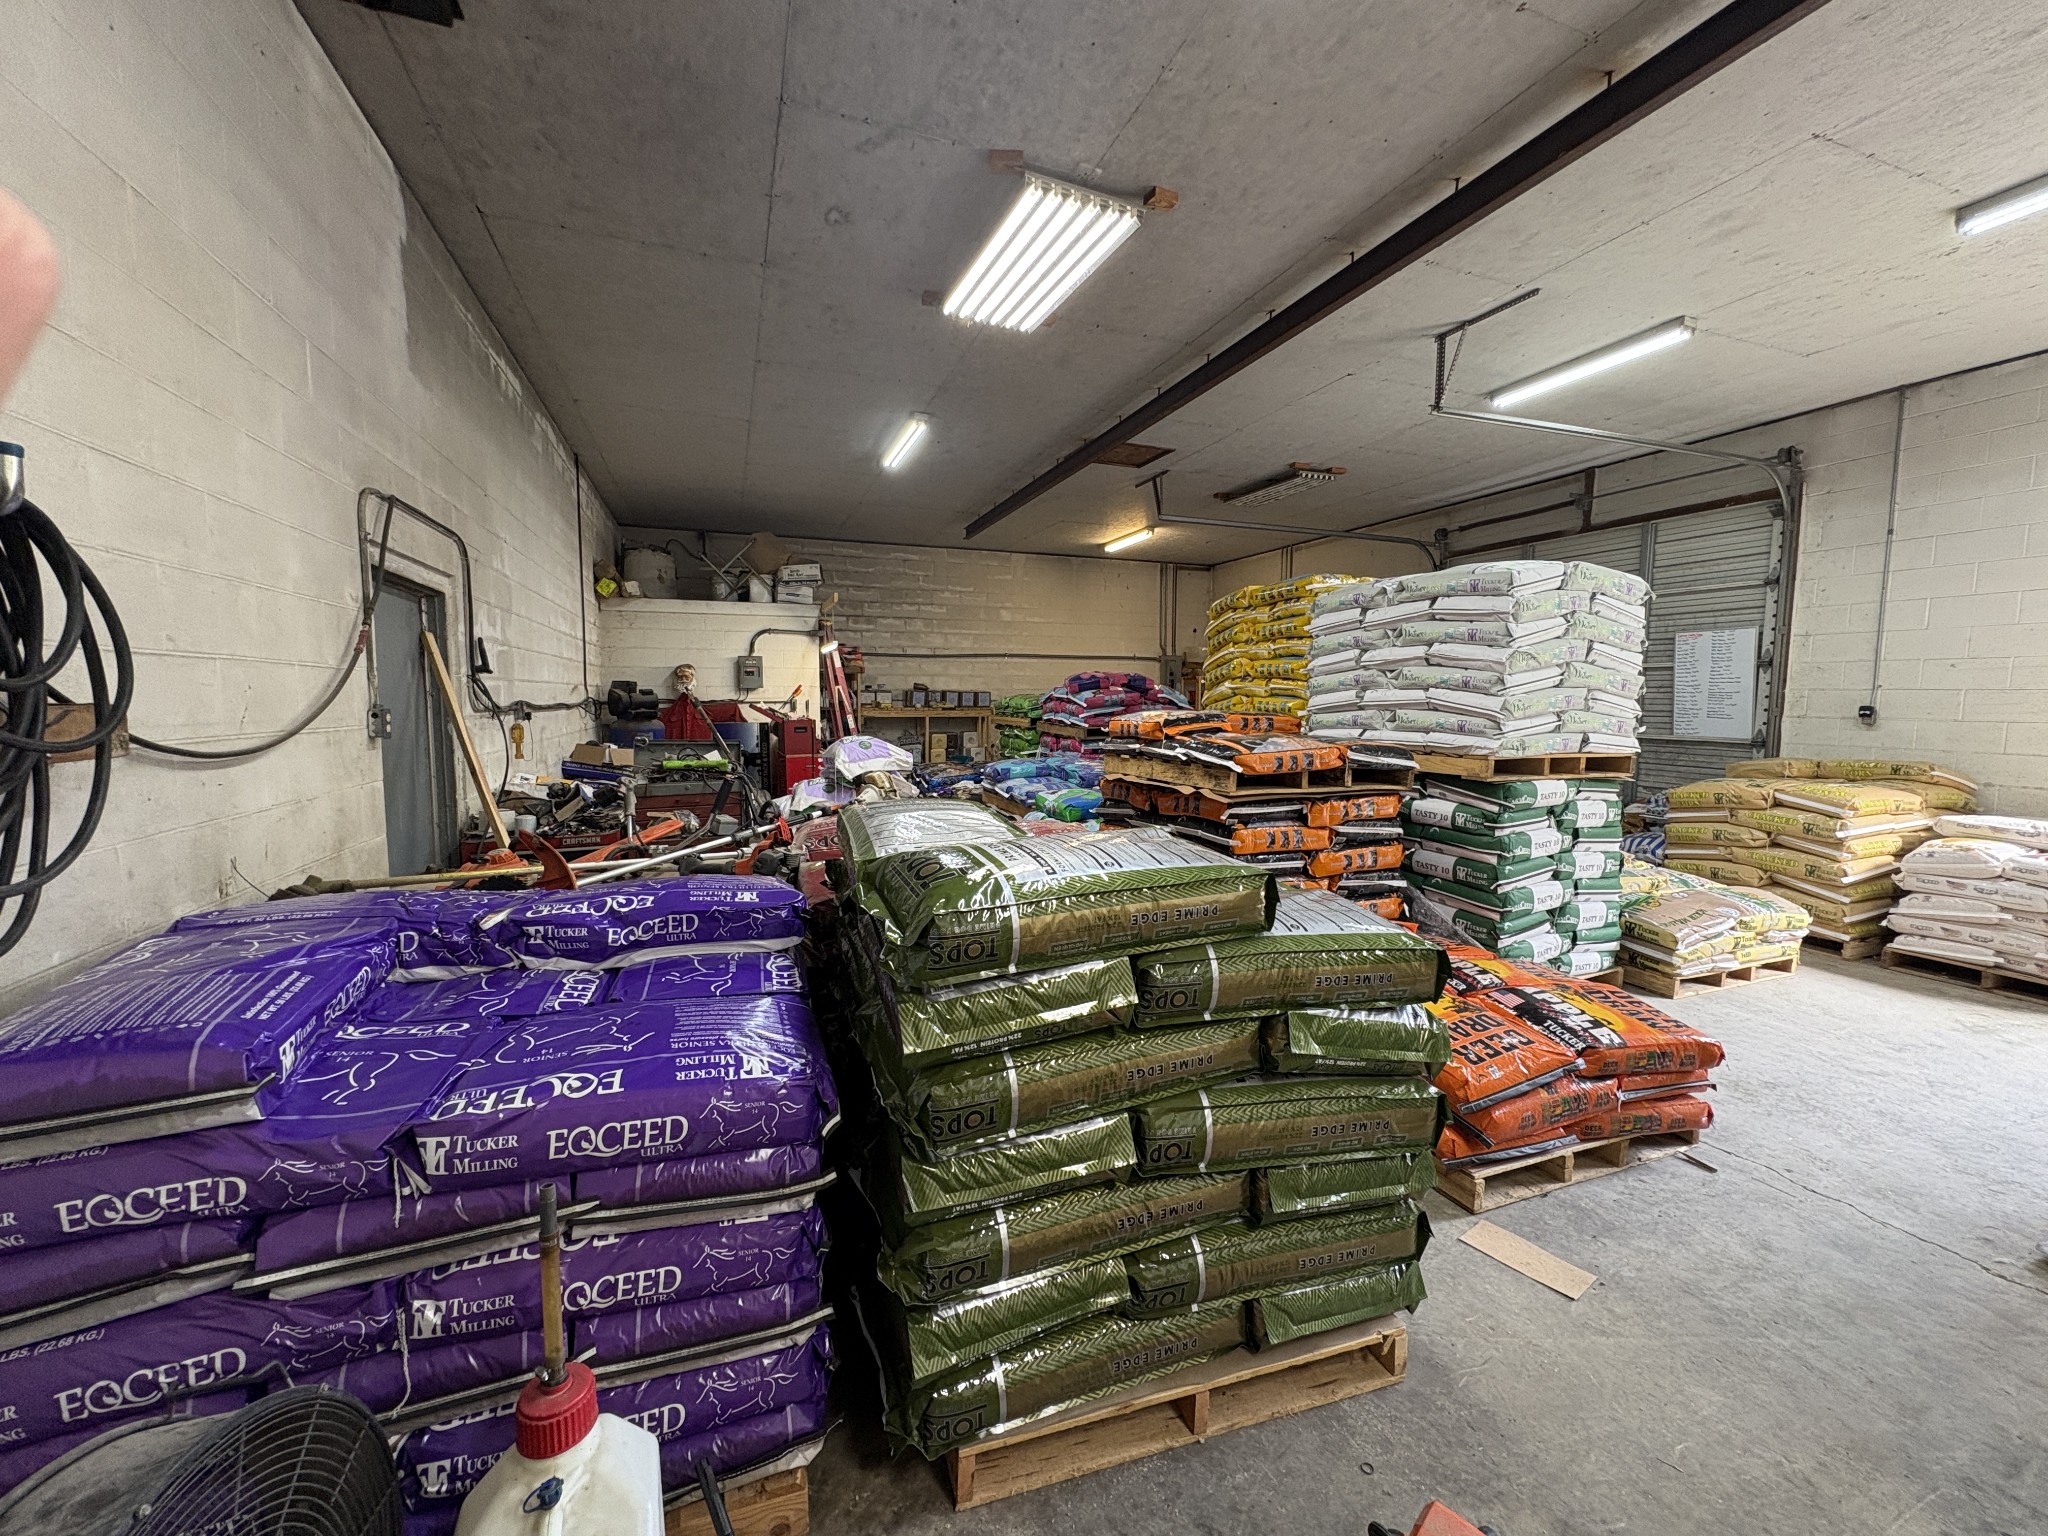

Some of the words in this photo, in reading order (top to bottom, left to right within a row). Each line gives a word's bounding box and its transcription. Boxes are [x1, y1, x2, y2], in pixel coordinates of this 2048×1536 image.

[1414, 808, 1438, 820] TASTY
[1439, 813, 1448, 821] 10
[1745, 811, 1799, 826] CRACKED
[1755, 822, 1786, 833] CORN
[562, 837, 601, 845] CRAFTSMAN
[1415, 860, 1440, 872] TASTY
[1440, 866, 1450, 875] 10
[1744, 851, 1799, 868] CRACKED
[1467, 869, 1488, 879] TUCKER
[1130, 909, 1169, 926] EDGE
[1173, 904, 1218, 921] PRIME
[545, 925, 589, 937] TUCKER
[606, 913, 699, 947] EQCEED
[1466, 921, 1488, 932] TUCKER
[1637, 925, 1660, 937] TUCKER
[549, 939, 590, 950] MILLING
[666, 932, 697, 942] ULTRA
[929, 936, 999, 965] TOPS
[1315, 975, 1349, 988] EDGE
[1353, 973, 1393, 985] PRIME
[1140, 987, 1199, 1010] TOPS
[1008, 1032, 1022, 1041] 22%
[1034, 1025, 1067, 1038] TOPS
[1543, 1020, 1587, 1051] TUCKER
[671, 1039, 716, 1049] SENIOR
[964, 1042, 978, 1050] 12%
[980, 1035, 1008, 1048] PROTEIN
[1451, 1028, 1536, 1066] DEER
[323, 1050, 374, 1058] SENIOR
[522, 1050, 568, 1063] SENIOR
[951, 1045, 963, 1055] FAT
[675, 1053, 737, 1066] MILLING
[1170, 1054, 1213, 1073] PRIME
[675, 1066, 738, 1081] TUCKER
[1127, 1063, 1164, 1082] EDGE
[744, 1100, 766, 1109] SENIOR
[930, 1106, 997, 1138] TOPS
[1311, 1122, 1345, 1138] EDGE
[1351, 1119, 1390, 1135] PRIME
[453, 1134, 519, 1154] TUCKER
[546, 1115, 689, 1160] EQCEED
[640, 1143, 684, 1158] ULTRA
[1149, 1140, 1192, 1162] TOP
[319, 1160, 346, 1172] SENIOR
[453, 1156, 519, 1175] MILLING
[53, 1175, 248, 1234] EQCEED
[1160, 1199, 1204, 1220] PRIME
[1117, 1211, 1154, 1231] EDGE
[737, 1247, 760, 1257] SENIOR
[1338, 1244, 1376, 1262] PRIME
[1300, 1254, 1333, 1270] EDGE
[924, 1261, 989, 1293] TOPS
[560, 1265, 683, 1312] QCEED
[448, 1294, 516, 1318] TUCKER
[633, 1292, 677, 1307] ULTRA
[314, 1321, 346, 1335] SENIOR
[449, 1315, 516, 1335] MILLING
[34, 1335, 75, 1357] (22.68
[75, 1328, 106, 1344] KG.)
[1155, 1337, 1198, 1359] PRIME
[1112, 1351, 1149, 1373] EDGE
[53, 1346, 248, 1424] EQCEED
[739, 1376, 762, 1387] SENIOR
[921, 1412, 985, 1443] TOPS
